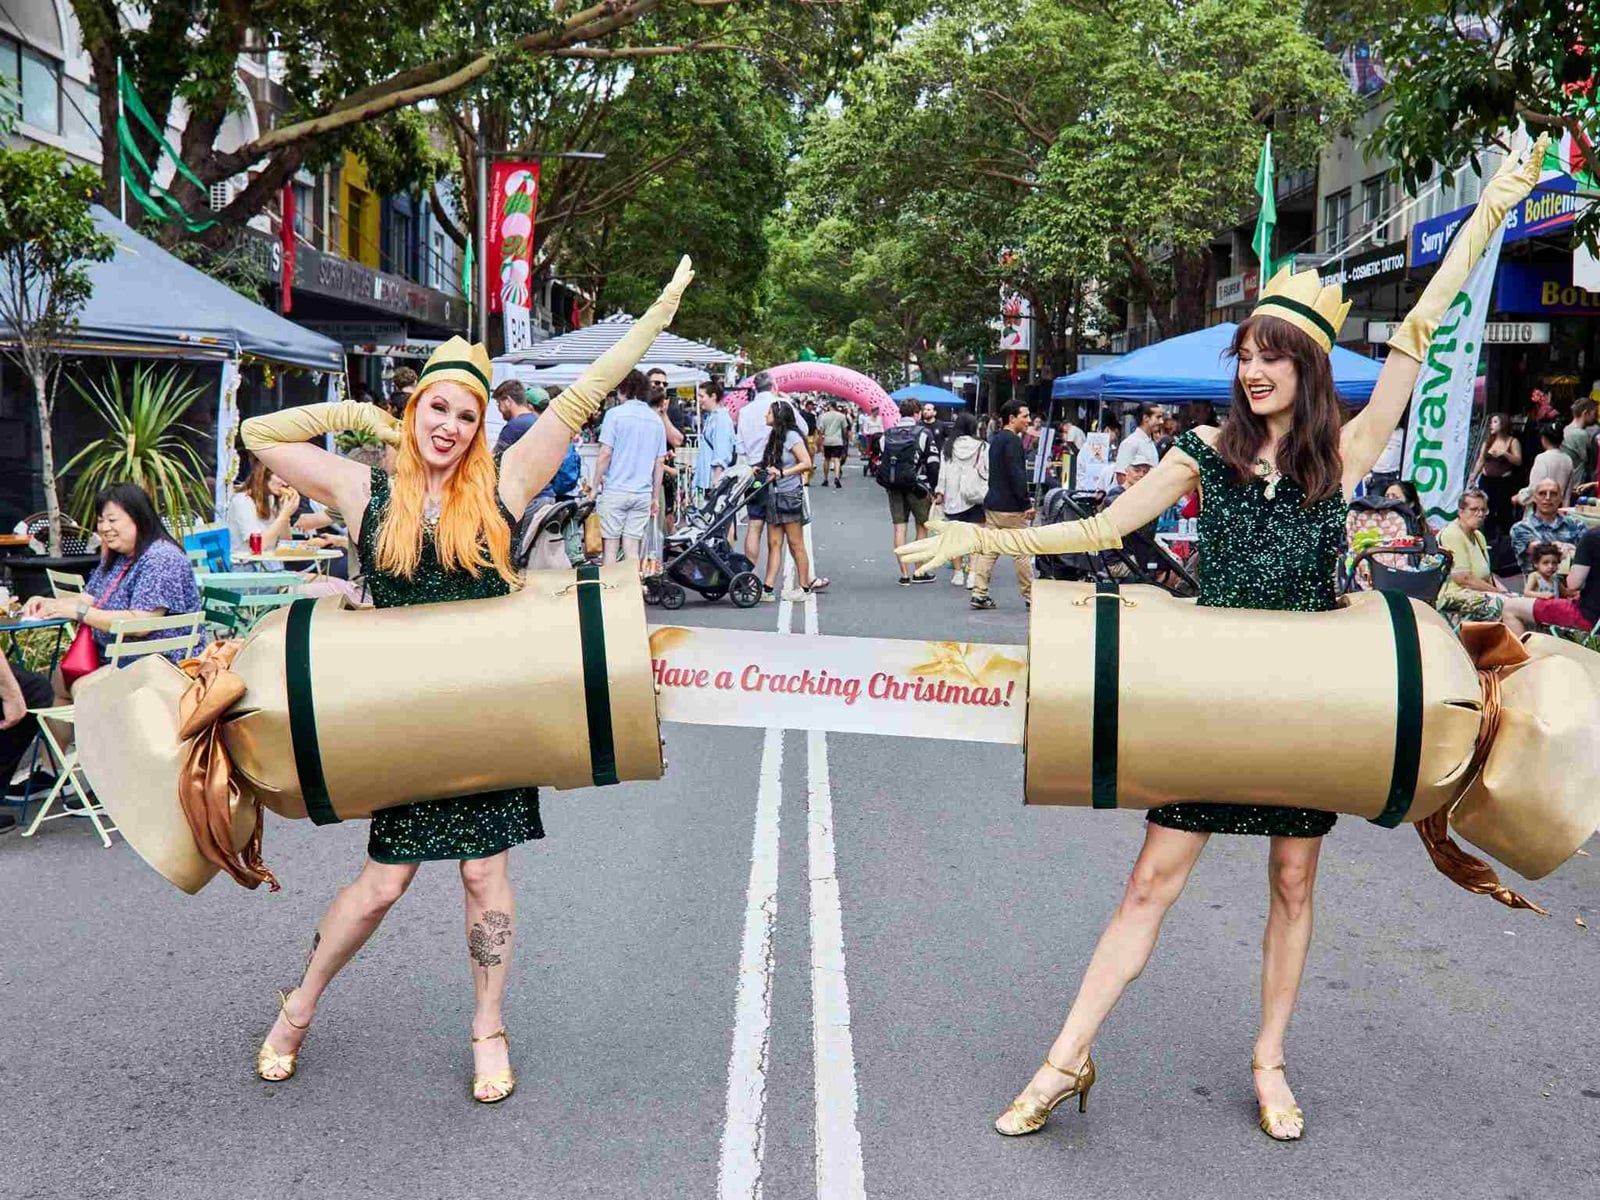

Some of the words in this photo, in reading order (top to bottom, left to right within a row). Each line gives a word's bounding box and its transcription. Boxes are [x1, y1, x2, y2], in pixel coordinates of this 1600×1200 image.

[1421, 231, 1443, 254] Surry
[1352, 261, 1380, 281] COSMETIC
[1381, 253, 1405, 273] TATTOO
[650, 658, 709, 689] Have
[714, 669, 735, 690] a
[740, 664, 863, 705] Cracking
[867, 671, 1016, 707] Christmas!
